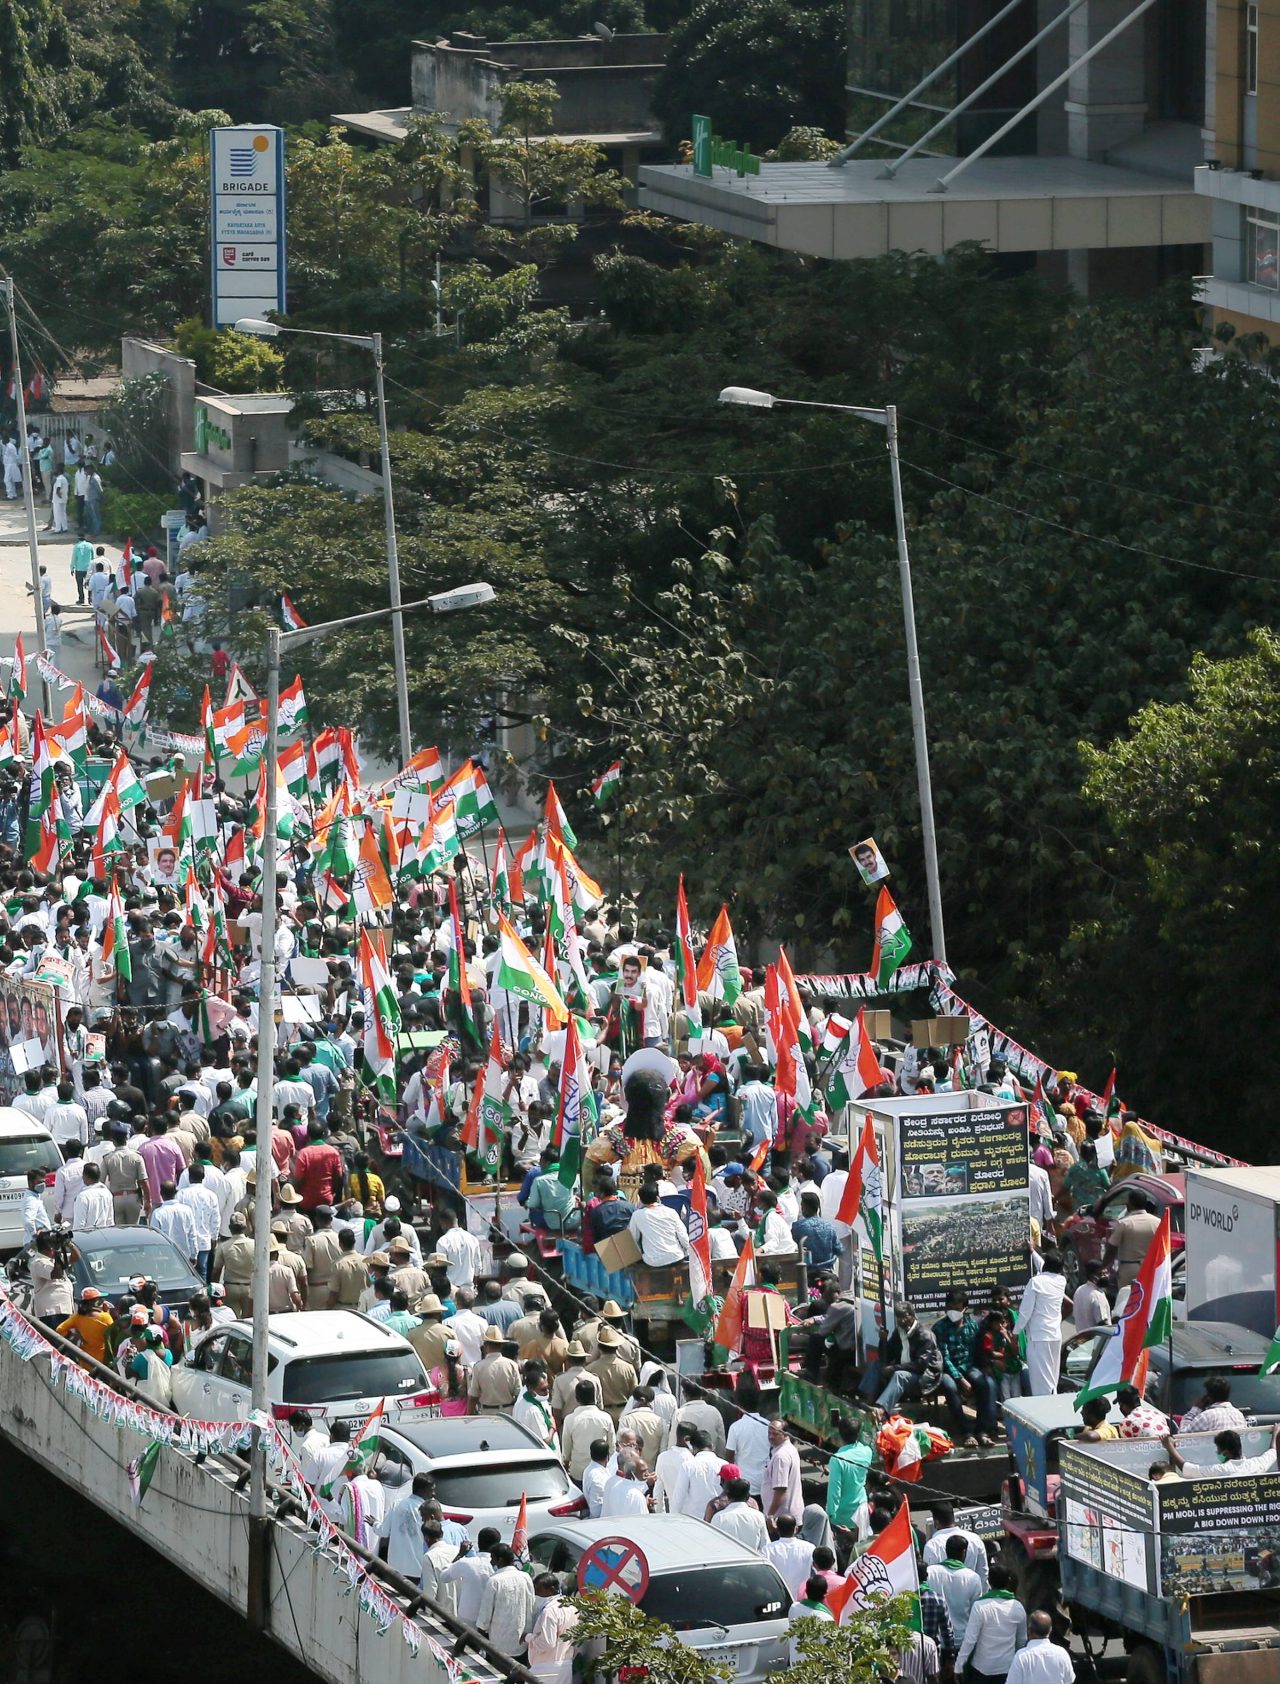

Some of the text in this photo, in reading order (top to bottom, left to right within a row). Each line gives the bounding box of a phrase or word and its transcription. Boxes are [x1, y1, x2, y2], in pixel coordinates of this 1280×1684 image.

[223, 183, 268, 191] BRIGADE
[904, 1112, 1001, 1128] ಕೇಂದ್ರ ಸರ್ಕಾರದ ವಿರೋಧಿ
[908, 1127, 945, 1137] ನೀತಿಯನ್ನು
[975, 1122, 1005, 1134] ಪ್ರತಿಭಟನೆ
[903, 1138, 948, 1149] ನಡೆಸುತ್ತಿರುವ
[952, 1136, 976, 1148] ರೈತರು
[905, 1150, 947, 1162] ಹೋರಾಟಕ್ಕೆ
[974, 1170, 1004, 1179] ತೋರದ
[969, 1177, 1026, 1193] ಪ್ರಧಾನಿ ಮೋದಿ
[1191, 1202, 1233, 1232] DP WORLD
[398, 1378, 416, 1388] JP
[1192, 1482, 1222, 1493] ಪ್ರಧಾನಿ
[1224, 1479, 1257, 1488] ನರೇಂದ್ರ
[1192, 1494, 1228, 1504] ಕಸಿಯುವ
[1230, 1491, 1260, 1502] ಯತ್ನಕ್ಕೆ
[1163, 1512, 1174, 1520] PM
[1176, 1510, 1197, 1518] MODI,
[1206, 1505, 1253, 1516] SUPPRESSING
[1201, 1520, 1214, 1528] BIG
[1216, 1518, 1239, 1526] DOWN
[1241, 1516, 1264, 1524] DOWN
[762, 1602, 781, 1613] JP
